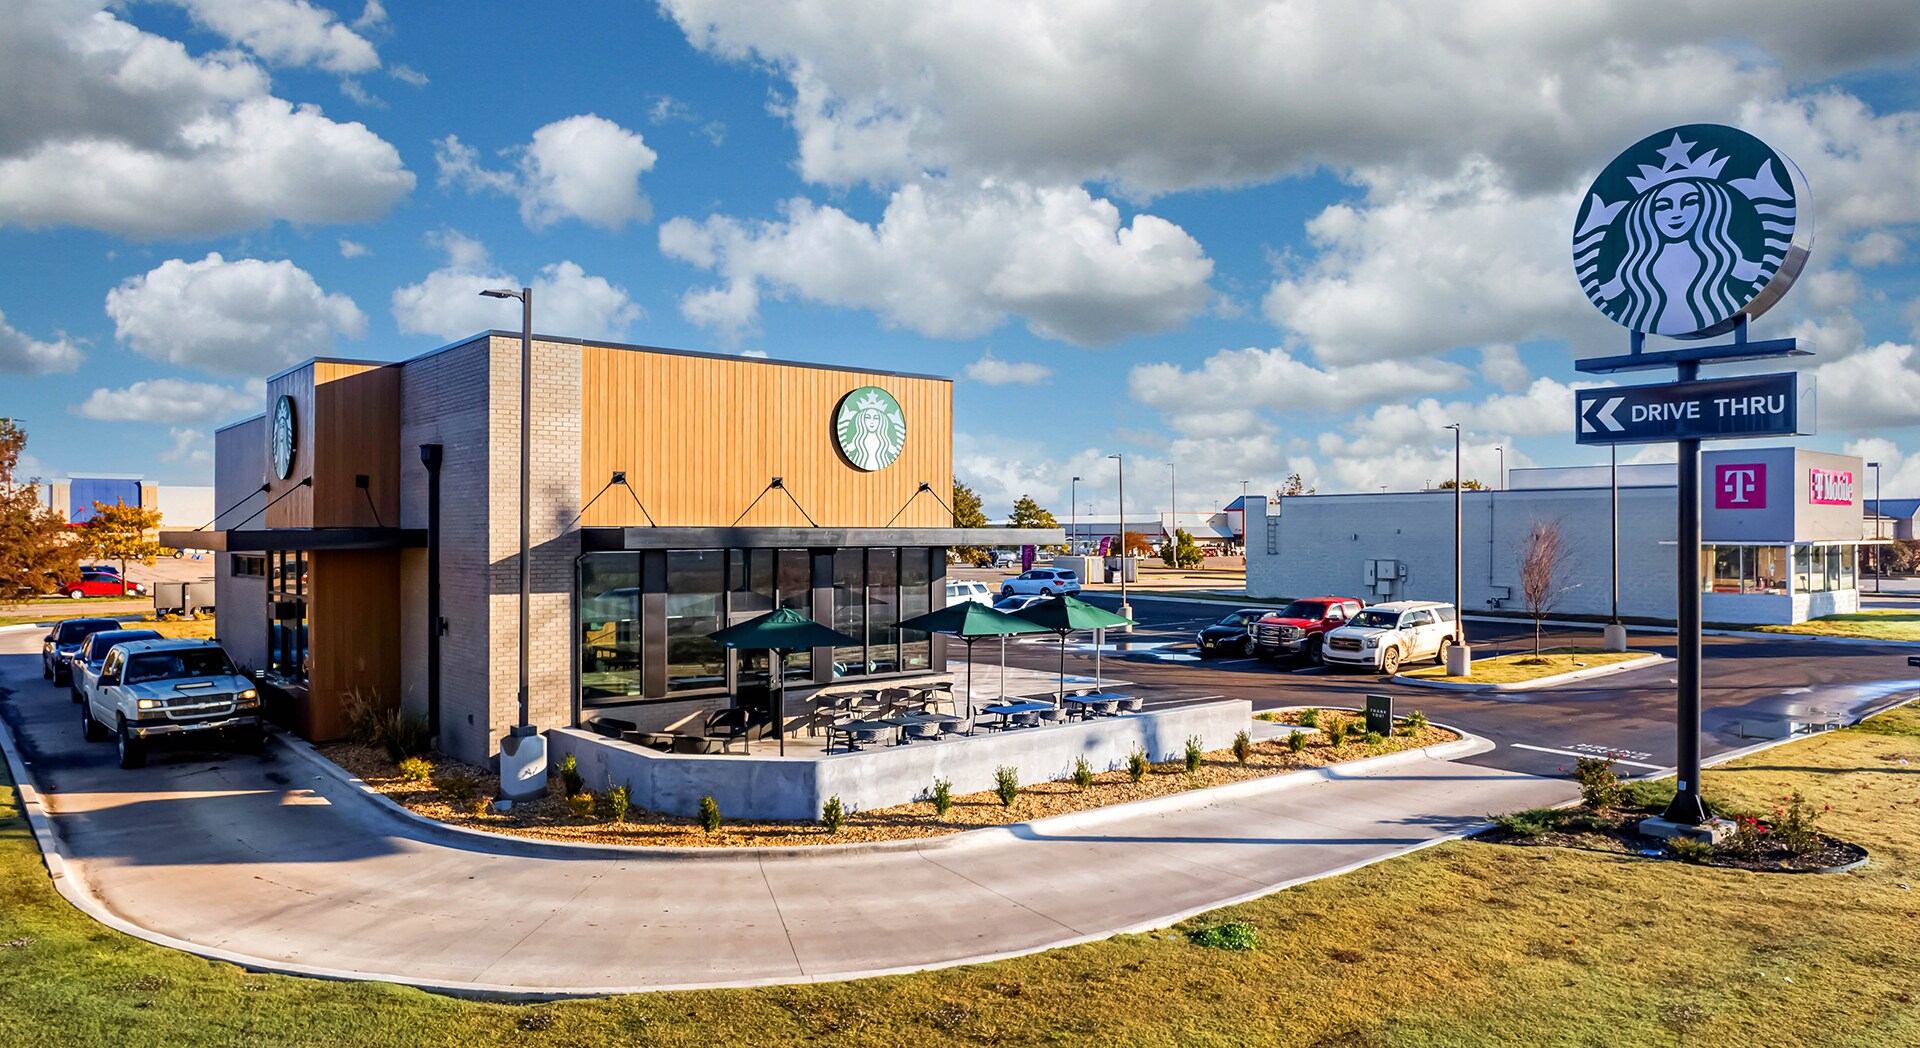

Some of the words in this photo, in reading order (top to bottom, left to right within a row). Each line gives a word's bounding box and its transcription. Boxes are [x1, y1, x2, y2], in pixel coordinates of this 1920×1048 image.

[1631, 401, 1700, 422] DRIVE
[1714, 394, 1785, 417] THRU
[1725, 470, 1755, 503] T
